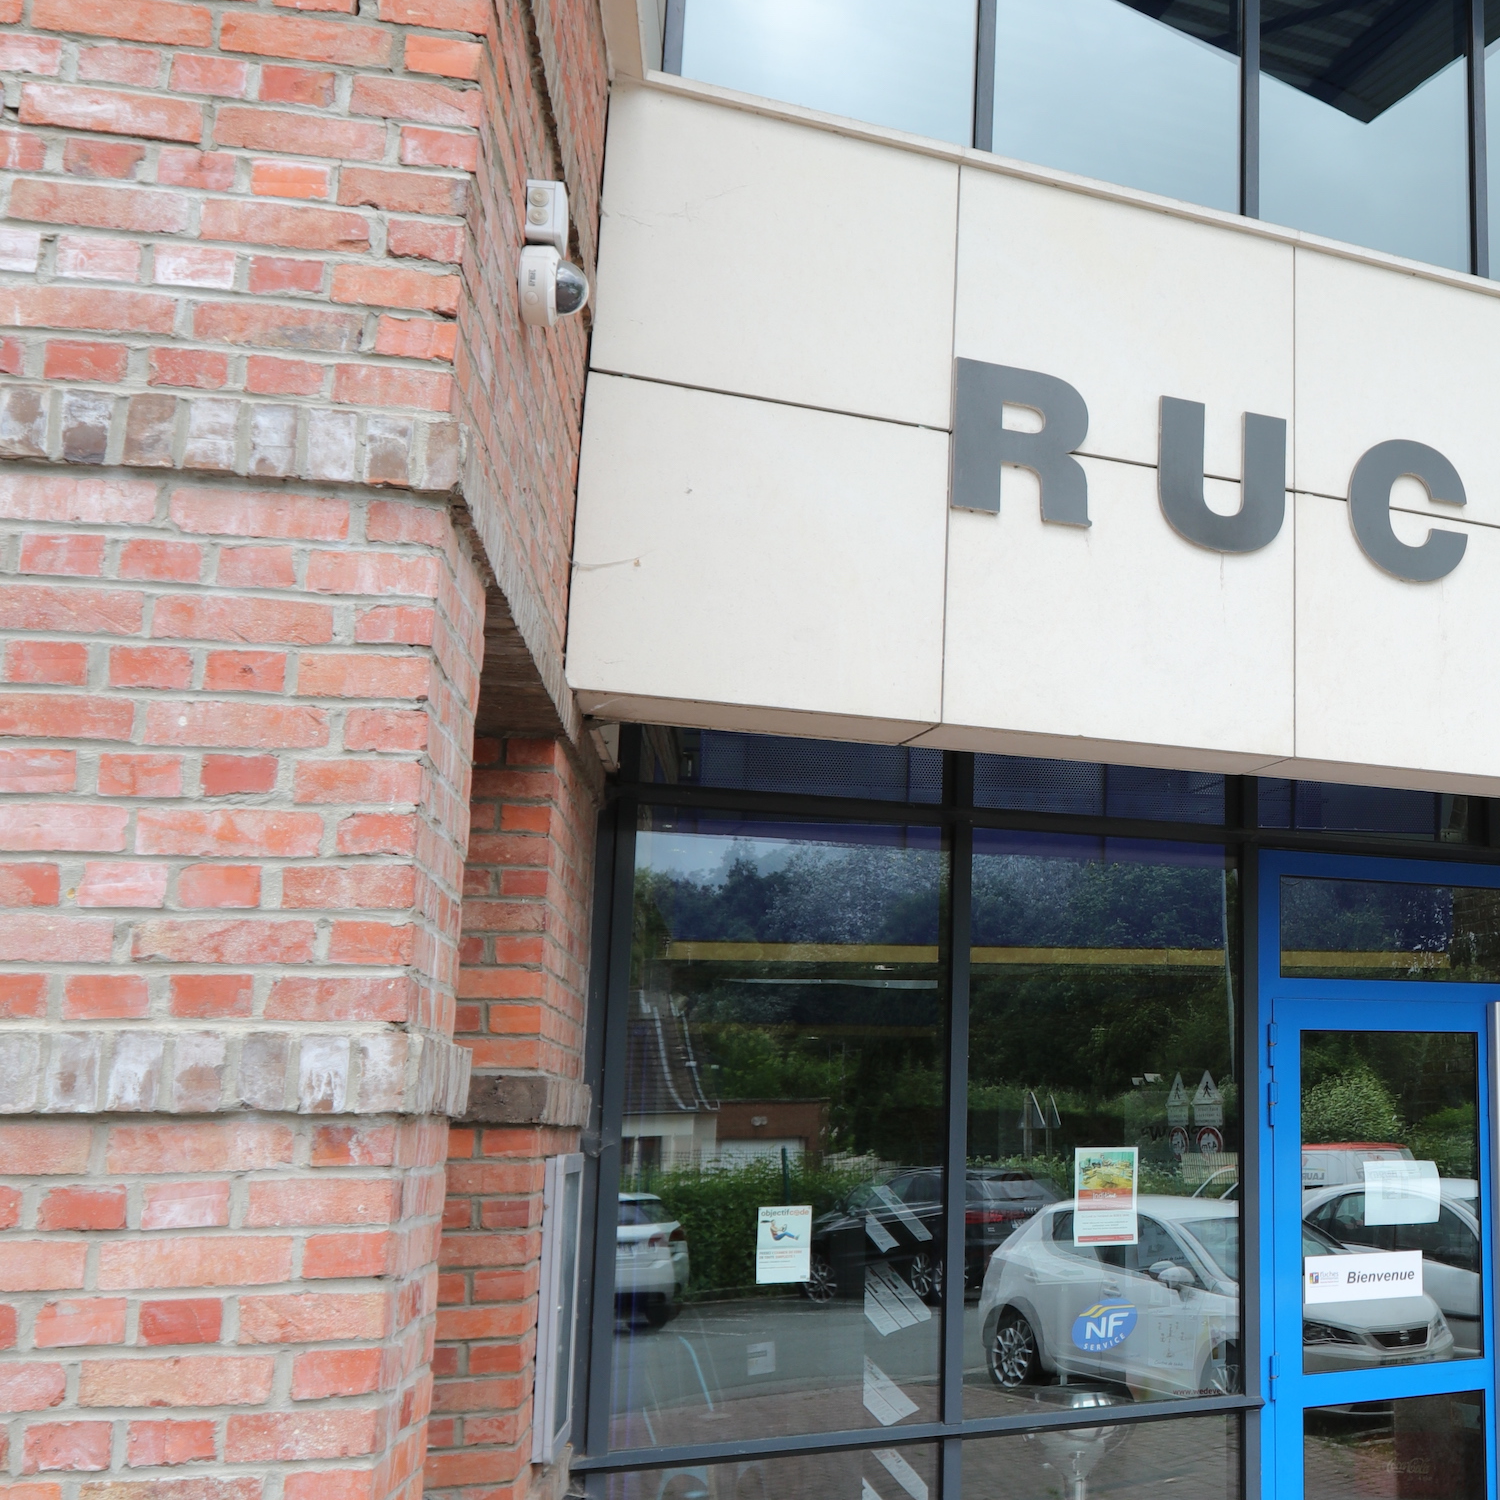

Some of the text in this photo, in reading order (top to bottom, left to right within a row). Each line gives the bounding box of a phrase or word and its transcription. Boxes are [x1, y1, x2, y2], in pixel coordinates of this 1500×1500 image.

[1346, 1270, 1415, 1284] Bienvenue
[1085, 1312, 1129, 1340] NF
[1083, 1332, 1126, 1350] SERVICE
